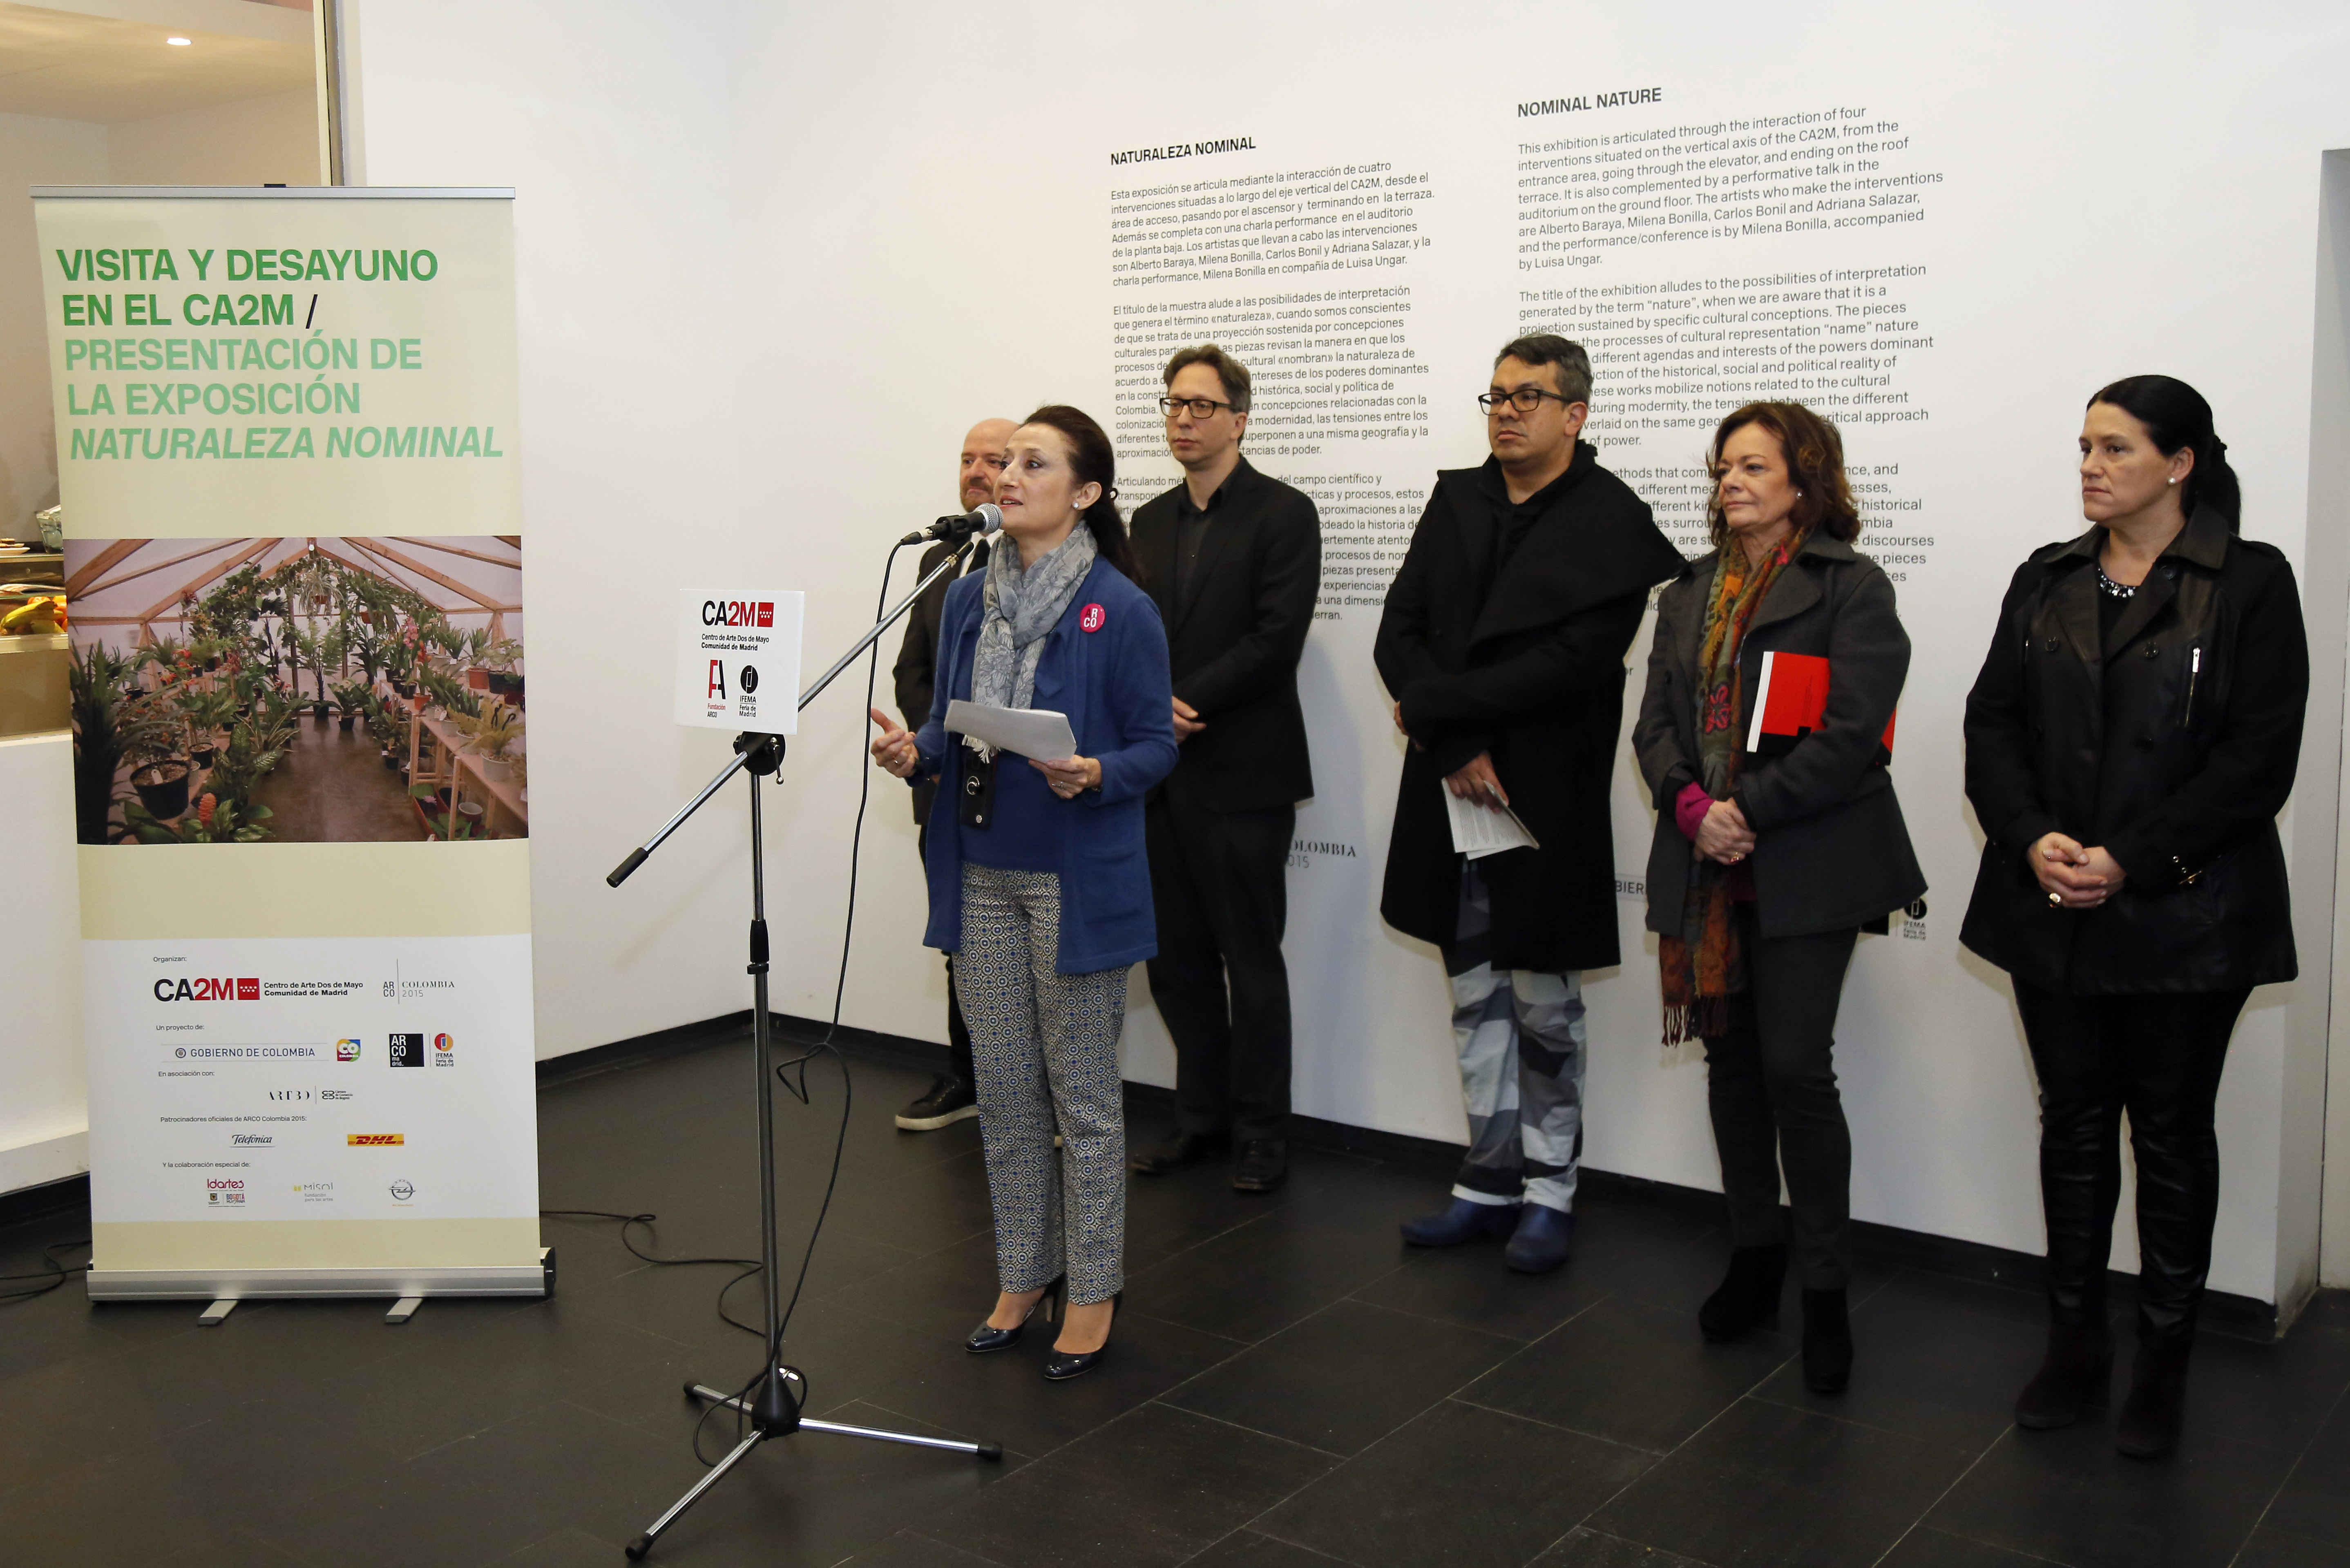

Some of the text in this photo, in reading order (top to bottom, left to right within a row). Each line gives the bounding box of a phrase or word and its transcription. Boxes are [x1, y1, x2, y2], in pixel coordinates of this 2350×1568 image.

[1518, 87, 1662, 118] NOMINAL NATURE
[1518, 107, 1867, 155] This exhibition is articulated through the interaction of four
[1110, 136, 1257, 166] NATURALEZA NOMINAL
[1111, 161, 1392, 201] Esta exposición se articula mediante la interacción de cuatro
[56, 249, 438, 281] VISITA Y DESAYUNO
[1112, 255, 1408, 287] charla performance, Milena Bonilla en compañía de Luisa Ungar.
[63, 294, 112, 326] EN
[125, 294, 172, 325] EL
[183, 294, 293, 326] CA2M
[1113, 285, 1410, 316] El título de la muestra alude a las posibilidades de interpretación
[65, 329, 422, 371] PRESENTACIÓN DE
[1592, 336, 1934, 364] different agendas and interests of the powers dominant
[67, 374, 360, 415] LA EXPOSICIÓN
[1255, 410, 1428, 426] modernidad, las tensiones entre los
[69, 426, 503, 460] NATURALEZA NOMINAL
[1590, 436, 1642, 447] of power.
[1862, 534, 1935, 546] discourses
[702, 600, 756, 627] CA2M
[755, 636, 769, 644] Mayo
[1290, 839, 1356, 857] OLOMBIA
[154, 978, 234, 1002] CA2M
[190, 1048, 315, 1057] GOBIERNO DE COLOMBIA
[391, 1035, 406, 1046] AR
[391, 1046, 406, 1056] CO
[355, 1136, 397, 1144] DHL
